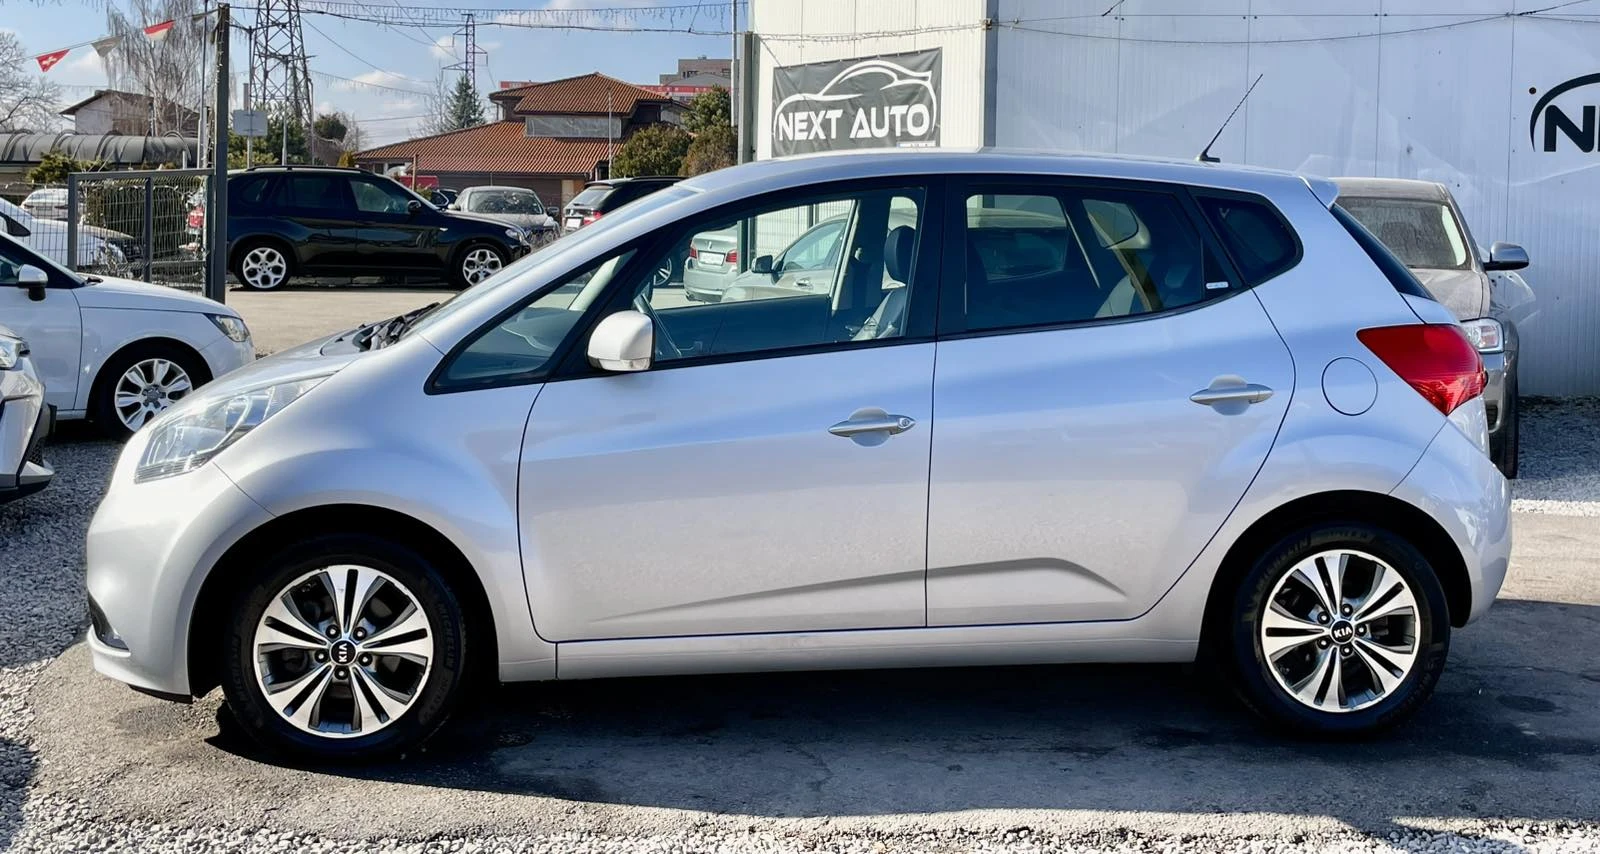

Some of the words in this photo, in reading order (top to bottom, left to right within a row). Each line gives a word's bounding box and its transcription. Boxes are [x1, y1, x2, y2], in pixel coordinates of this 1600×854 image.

[778, 109, 843, 141] NEXT
[850, 104, 930, 138] AUTO
[1544, 104, 1600, 153] N
[1333, 626, 1353, 638] KIA
[338, 643, 347, 663] KIA
